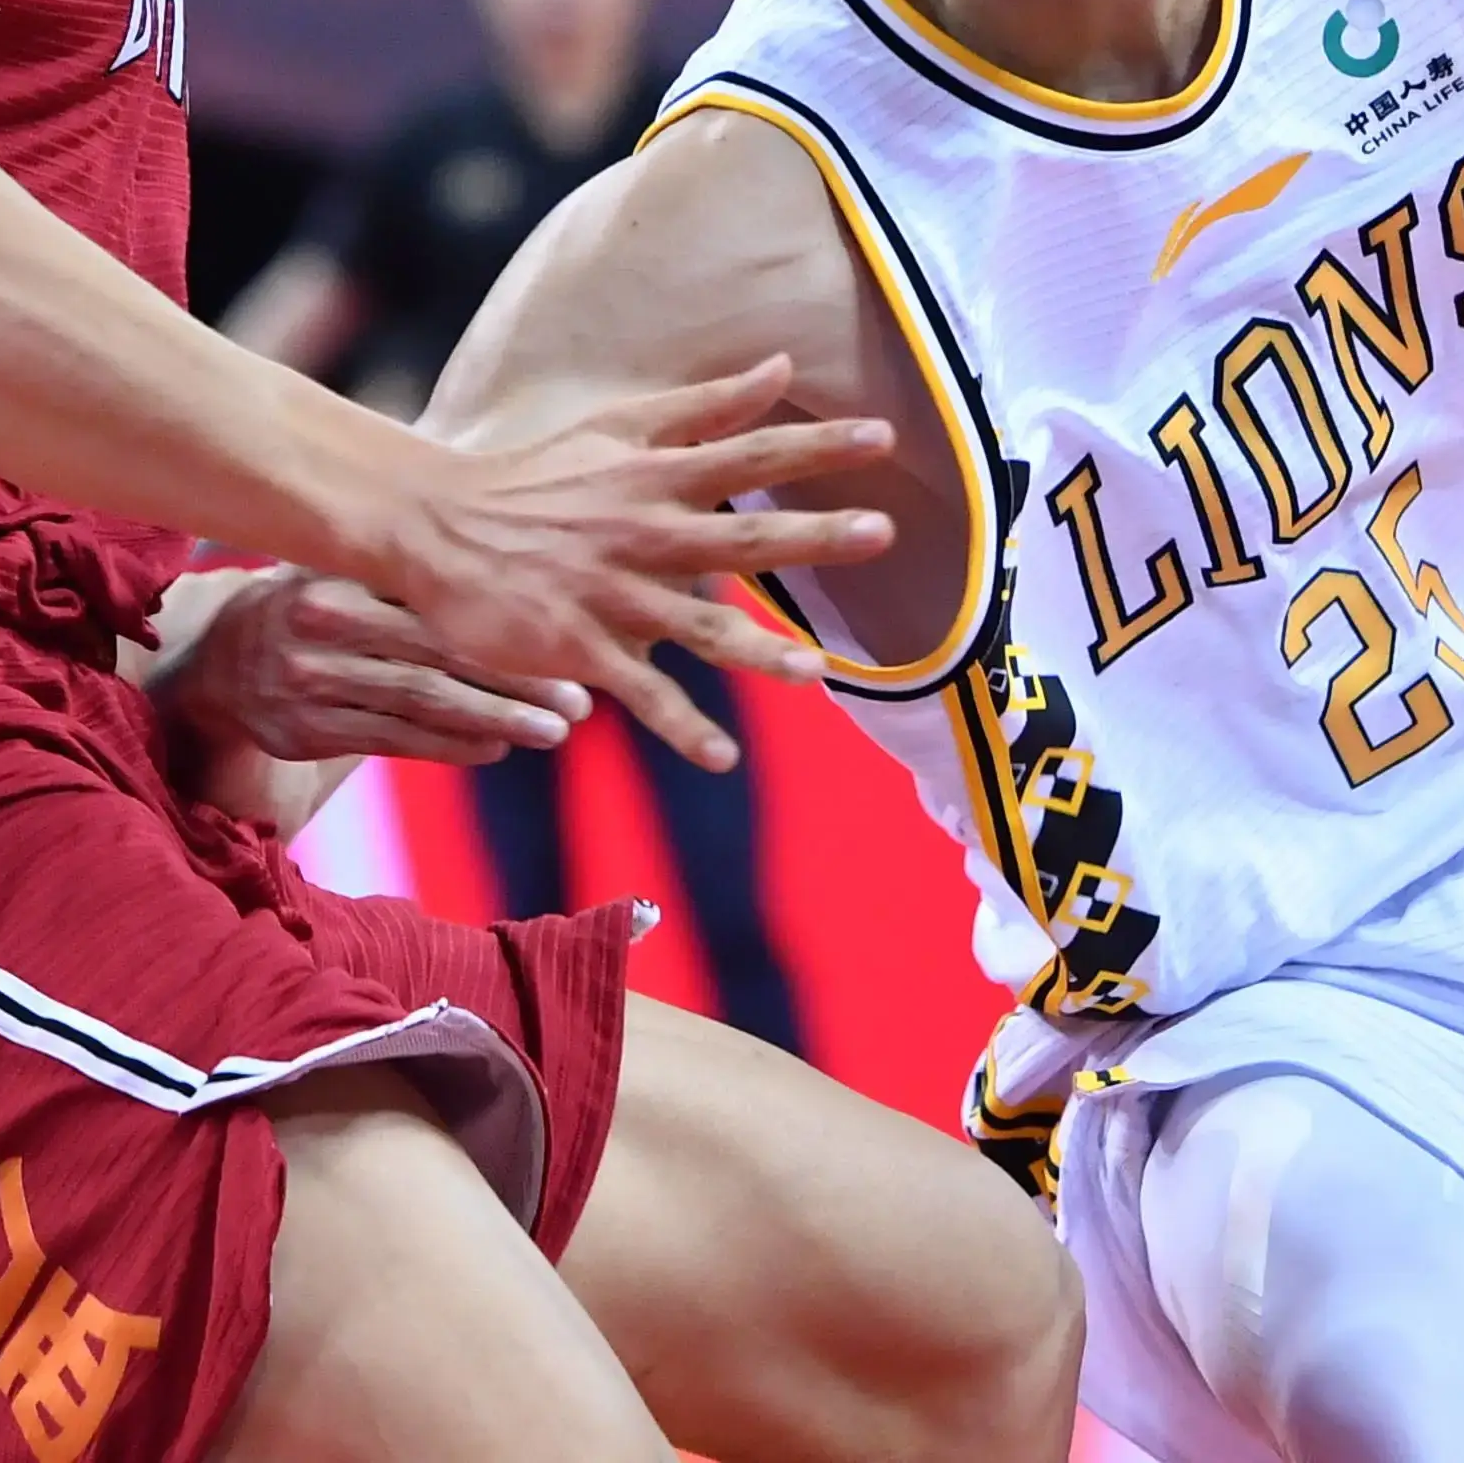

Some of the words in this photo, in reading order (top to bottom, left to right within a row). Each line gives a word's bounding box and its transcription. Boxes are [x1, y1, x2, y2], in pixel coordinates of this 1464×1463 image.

[1344, 52, 1454, 137] 中国人寿
[1361, 110, 1422, 155] CHINA
